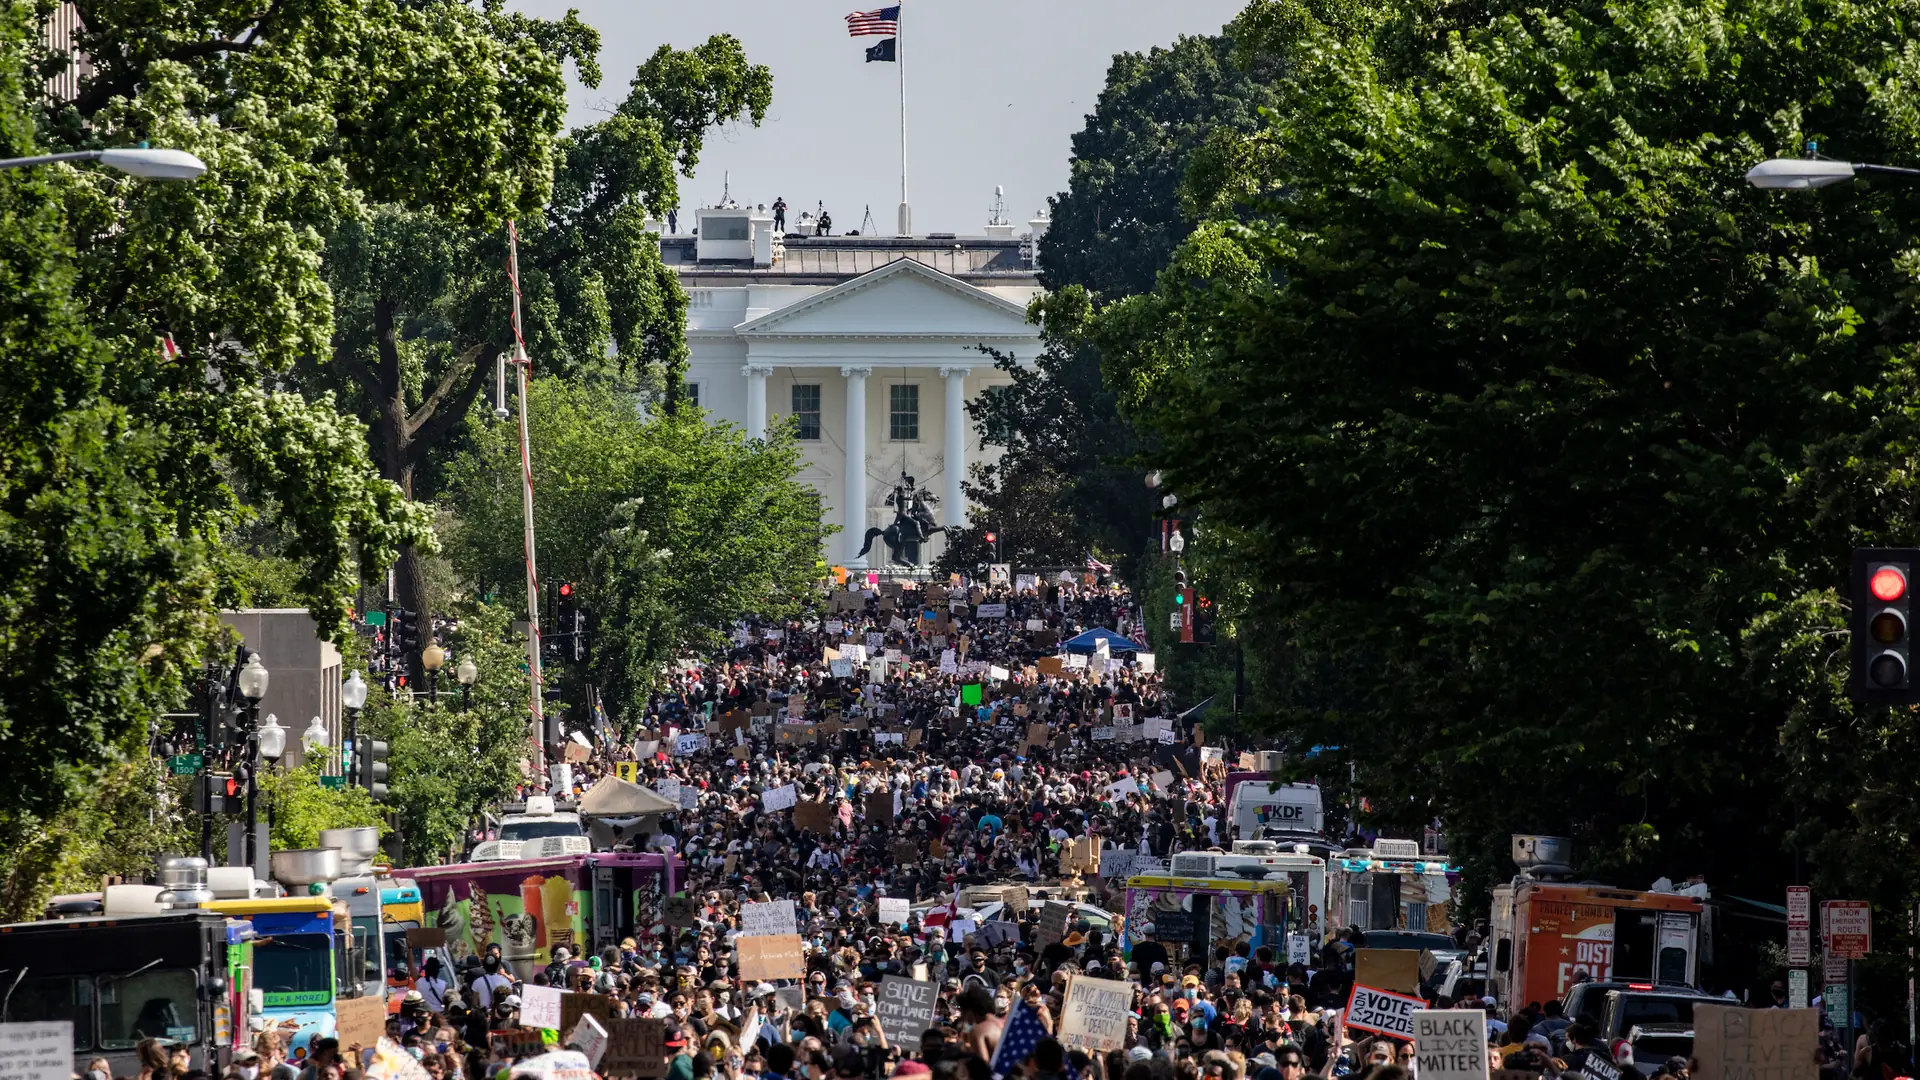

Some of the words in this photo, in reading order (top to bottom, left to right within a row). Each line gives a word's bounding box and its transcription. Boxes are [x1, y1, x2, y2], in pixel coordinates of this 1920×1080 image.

[176, 756, 183, 765] L
[176, 766, 195, 774] 1500
[1272, 805, 1304, 819] KDF
[1838, 909, 1861, 917] SNOW
[295, 994, 324, 1002] MORE!
[885, 981, 931, 1004] SILENCE
[1071, 984, 1097, 1006] POLICE
[877, 1000, 931, 1020] COMPLIANCE
[1354, 991, 1367, 1016] NOV
[1368, 992, 1413, 1017] VOTE
[1088, 1018, 1117, 1037] DEADLY
[1361, 1010, 1407, 1033] 2020
[1420, 1019, 1476, 1036] BLACK
[1419, 1040, 1480, 1052] LIVES
[1417, 1054, 1481, 1072] MATTER
